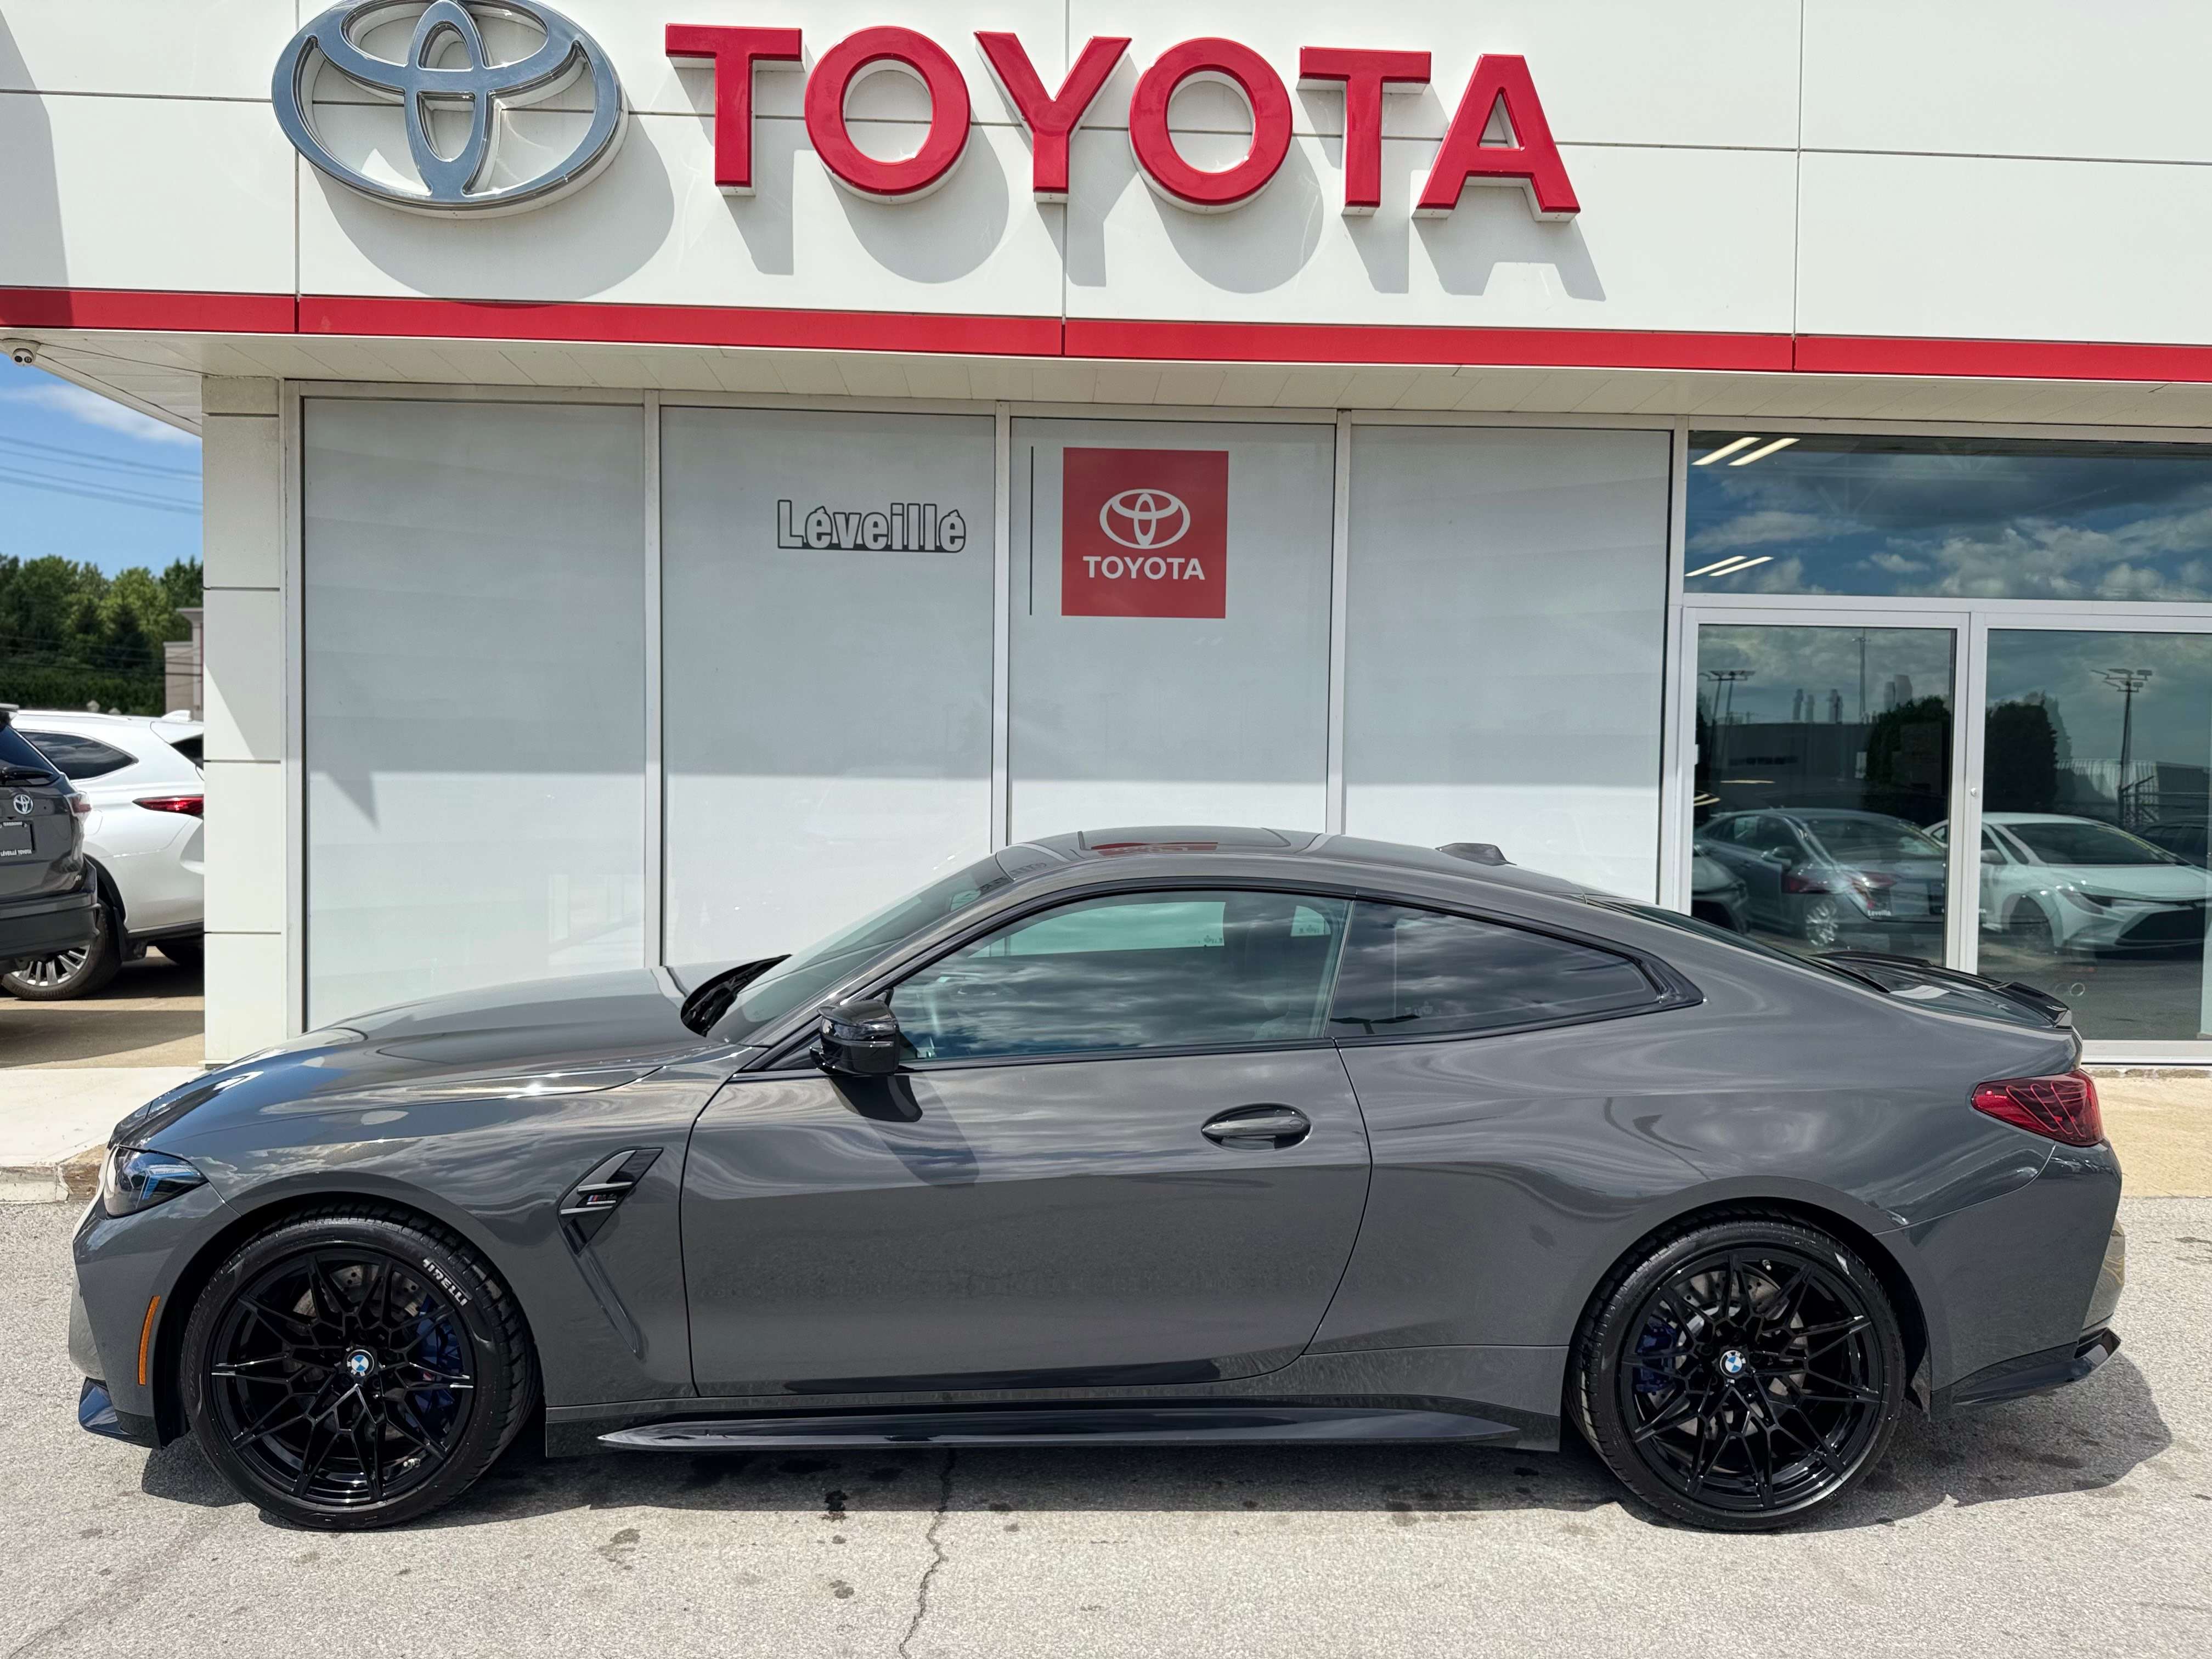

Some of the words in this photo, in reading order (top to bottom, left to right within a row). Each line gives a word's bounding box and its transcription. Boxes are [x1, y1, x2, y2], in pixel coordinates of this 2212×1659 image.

[665, 24, 1581, 221] TOYOTA
[777, 500, 966, 553] Léveillé
[1082, 556, 1205, 580] TOYOTA
[422, 1259, 468, 1306] PIRELLI
